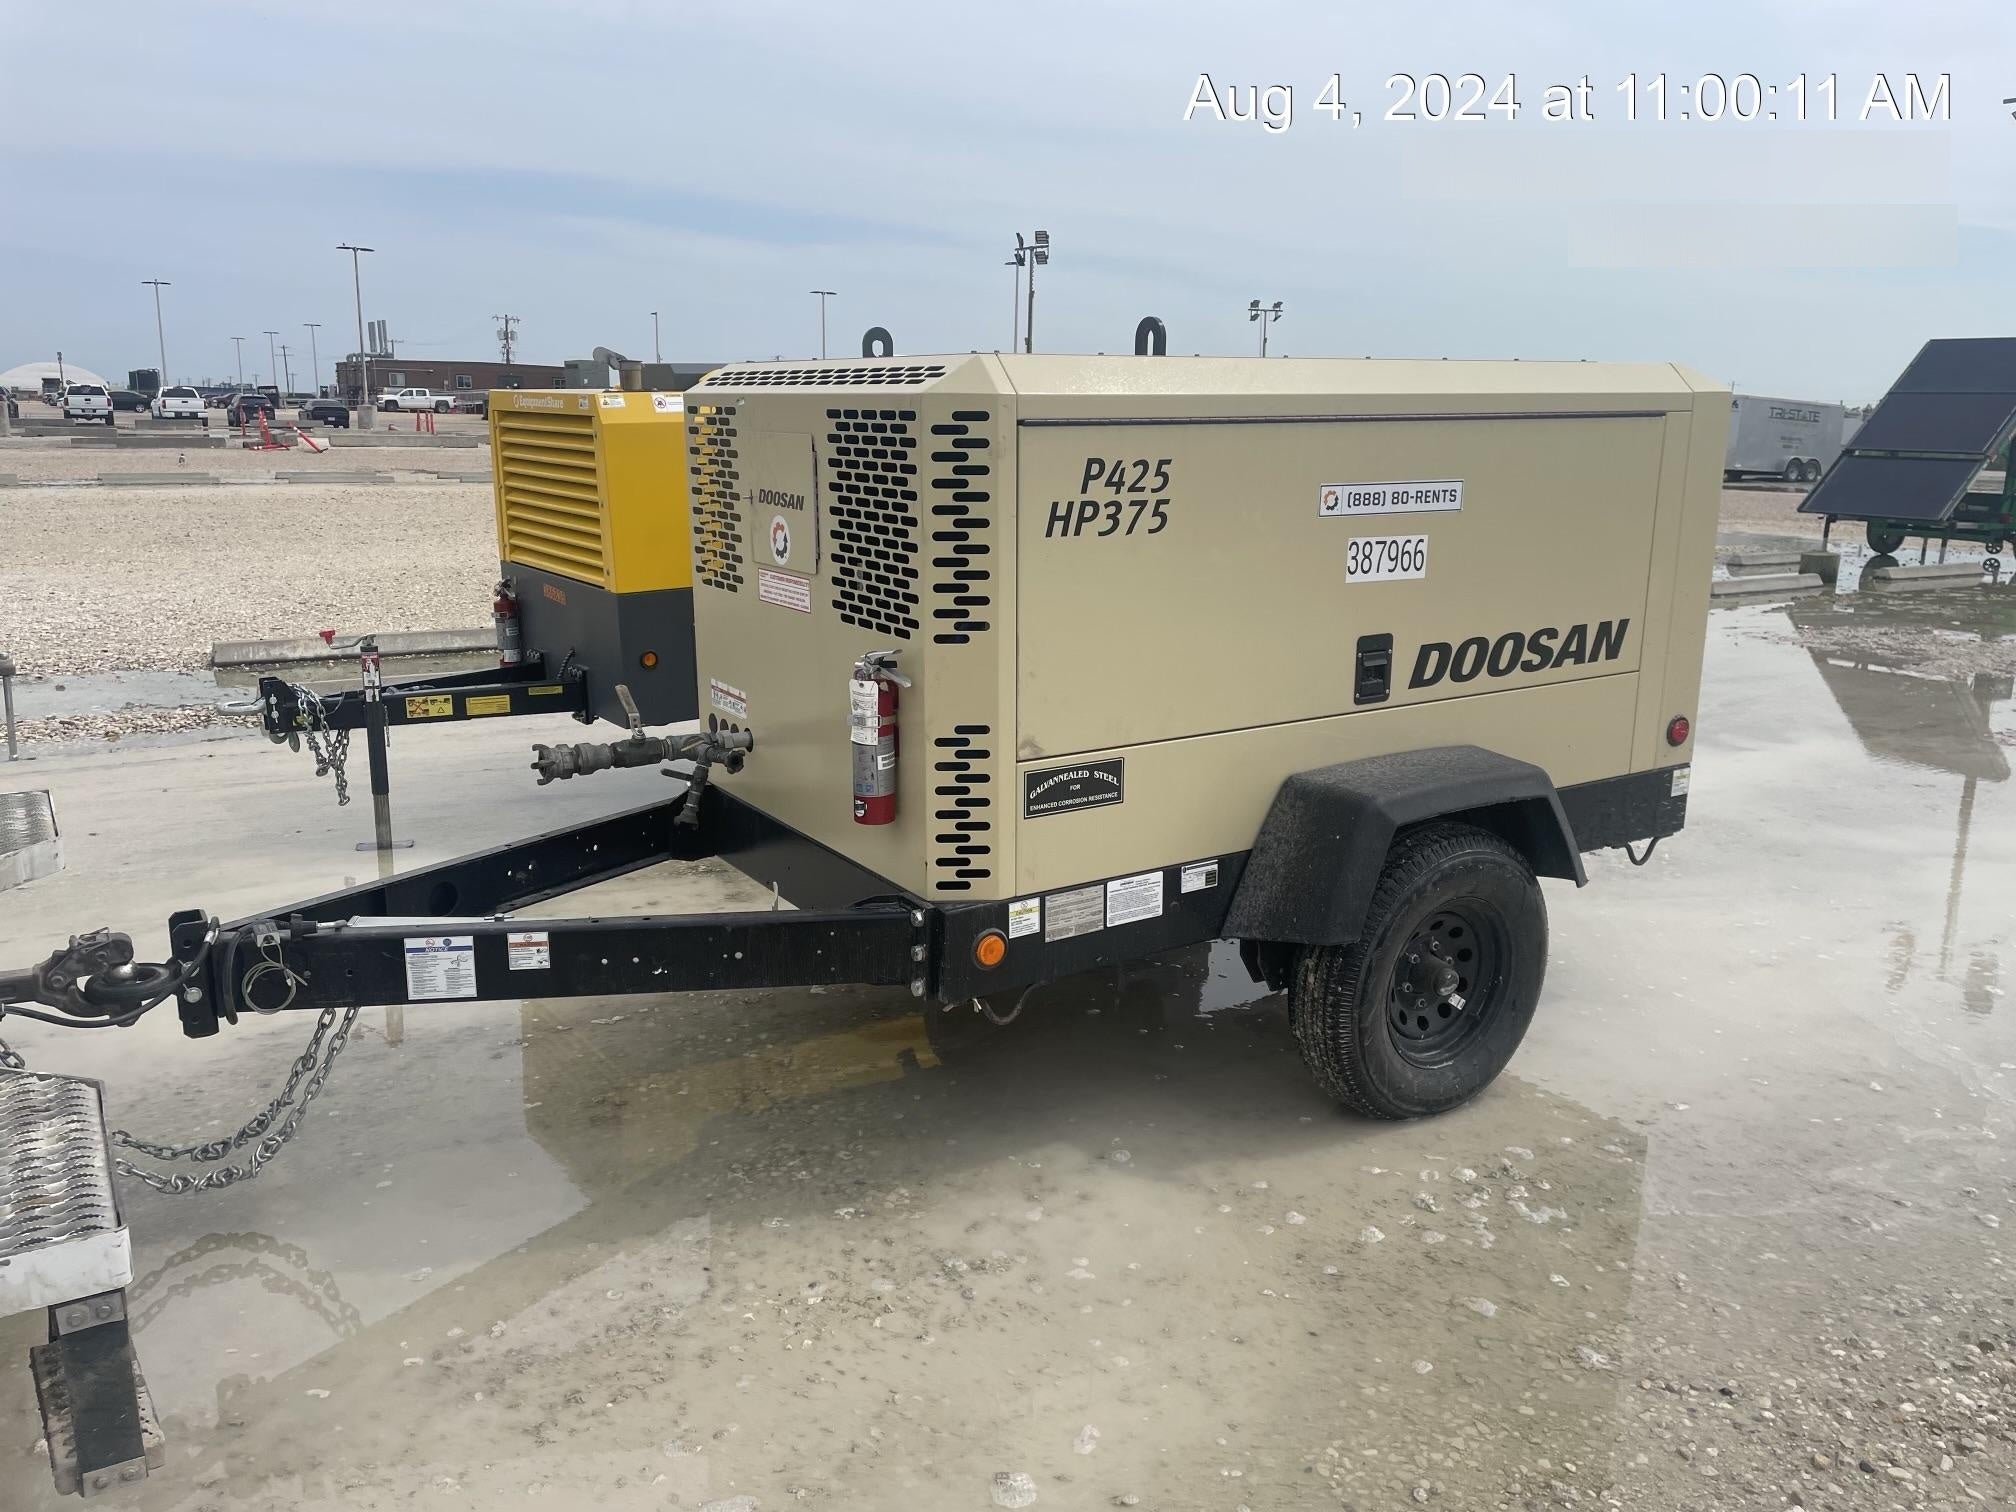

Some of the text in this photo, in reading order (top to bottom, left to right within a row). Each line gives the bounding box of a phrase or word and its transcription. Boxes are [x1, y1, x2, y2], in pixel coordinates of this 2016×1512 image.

[1080, 457, 1172, 495] P425
[758, 488, 805, 511] DOOSAN
[1347, 490, 1386, 508] (888)
[1045, 498, 1171, 538] HP375
[1347, 538, 1425, 575] 387966
[1407, 618, 1631, 690] DOOSAN
[1029, 770, 1120, 799] GALVANNEALED STEEL
[1029, 791, 1118, 812] ENHANCED CORROSION RESISTANCE
